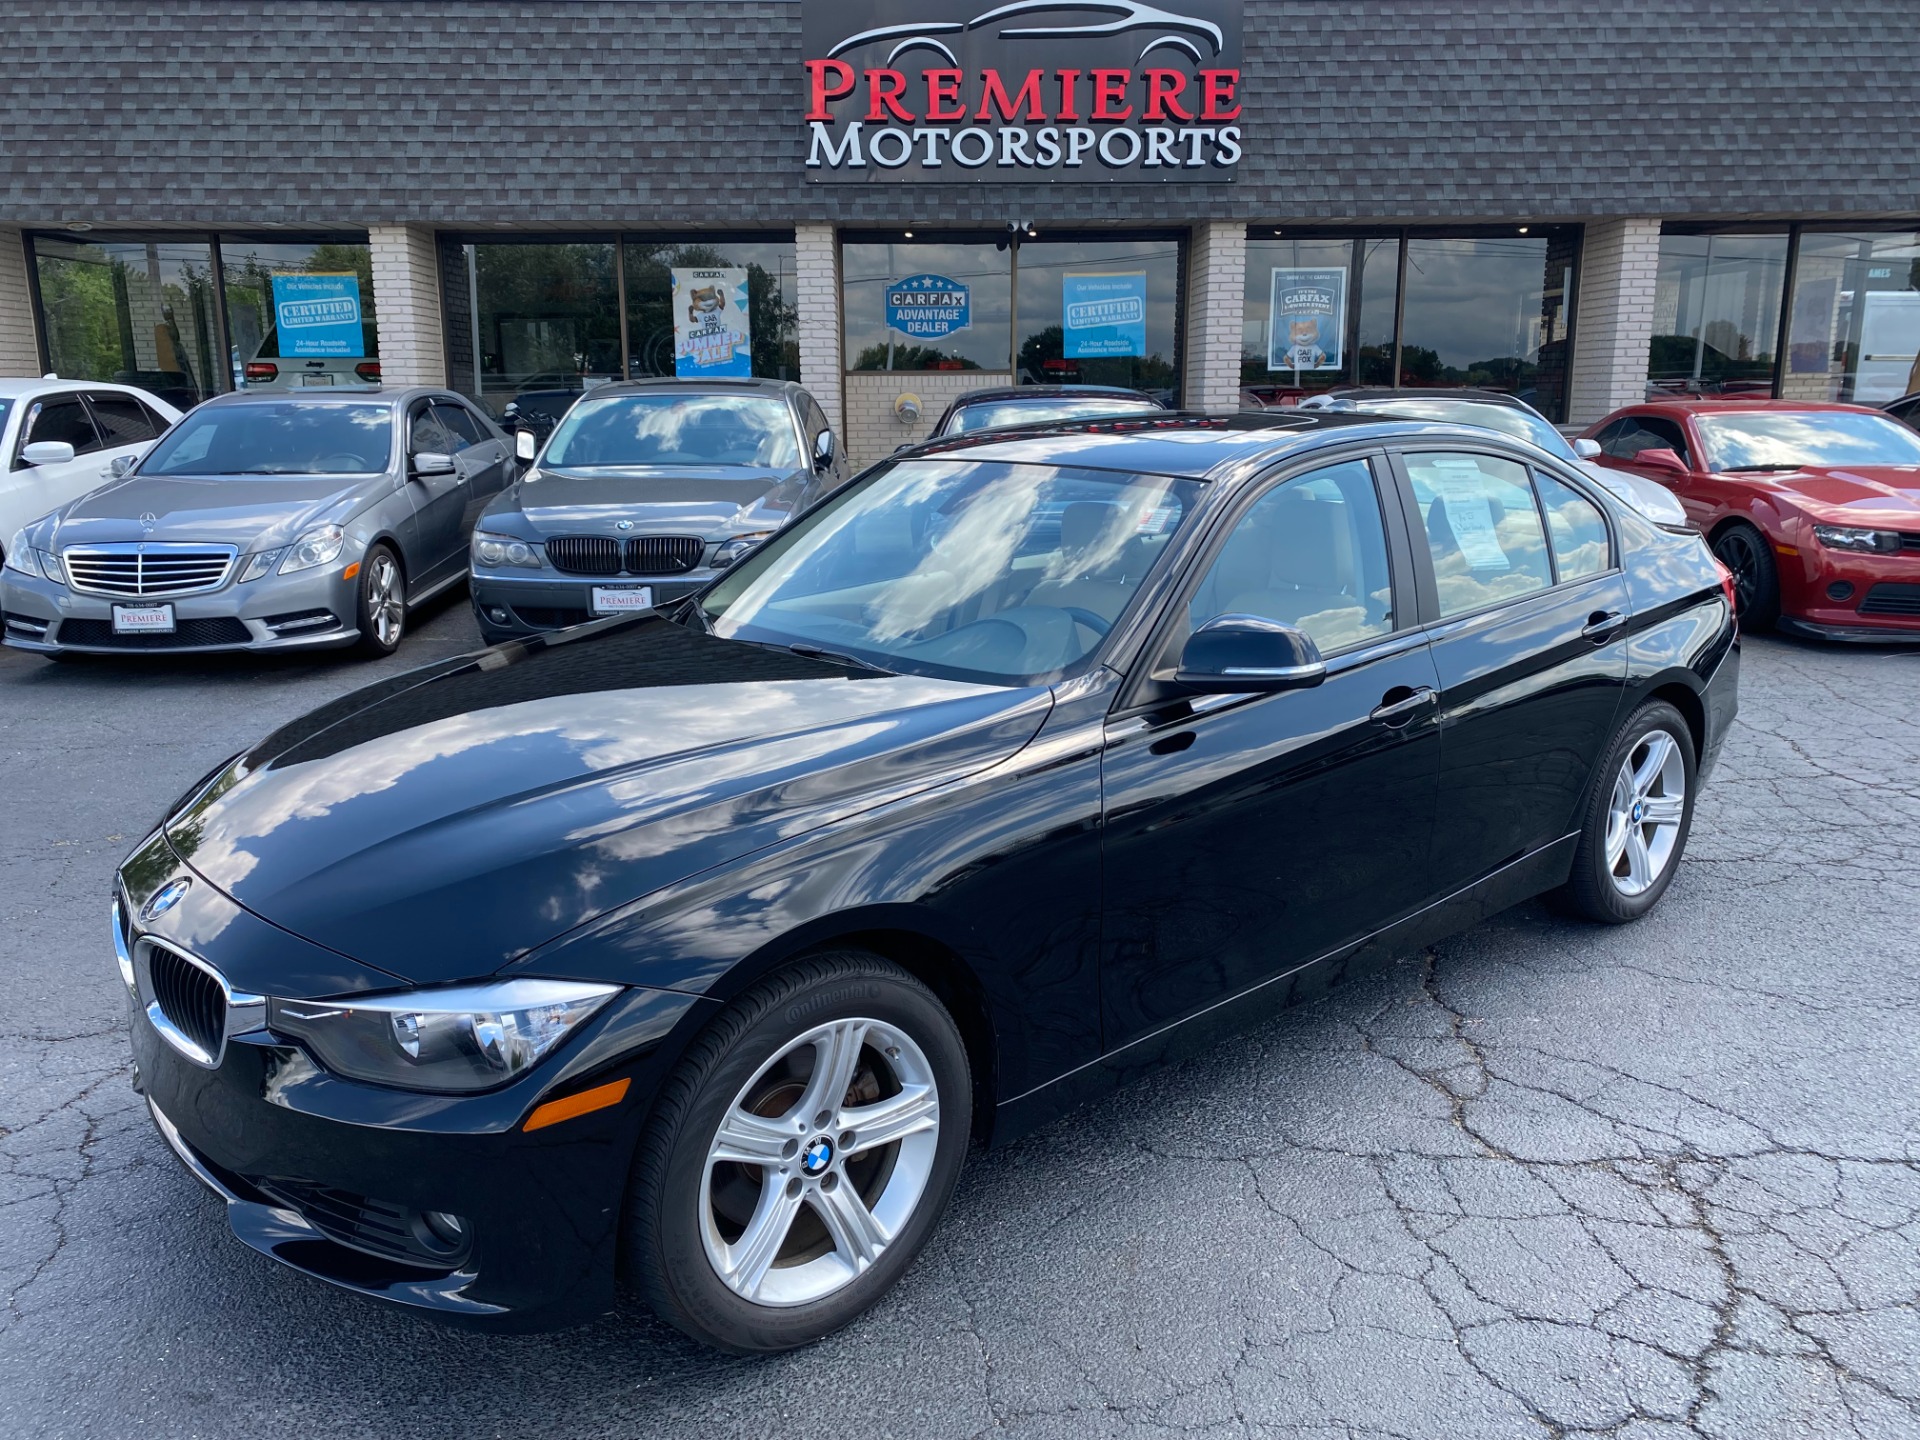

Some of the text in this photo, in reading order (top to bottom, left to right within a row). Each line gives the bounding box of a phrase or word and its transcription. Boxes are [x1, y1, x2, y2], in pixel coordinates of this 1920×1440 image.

[805, 60, 1242, 124] PREMIERE
[806, 122, 1242, 167] MOTORSPORTS
[892, 293, 963, 306] CARFAX
[1285, 294, 1331, 304] CARFAX
[283, 302, 353, 317] CERTIFIED
[896, 309, 960, 320] ADVANTAGE
[1071, 301, 1138, 318] CERTIFIED
[285, 313, 354, 325] LIMITED WARRANTY
[1072, 312, 1139, 326] LIMITED WARRANTY
[690, 326, 726, 338] CARFAX
[907, 322, 949, 332] DEALER
[676, 331, 746, 355] SUMMER
[694, 344, 733, 364] SALE
[600, 596, 646, 604] PREMIERE
[121, 614, 168, 622] PREMIERE
[785, 983, 868, 1025] Continental
[801, 1136, 822, 1169] BMW
